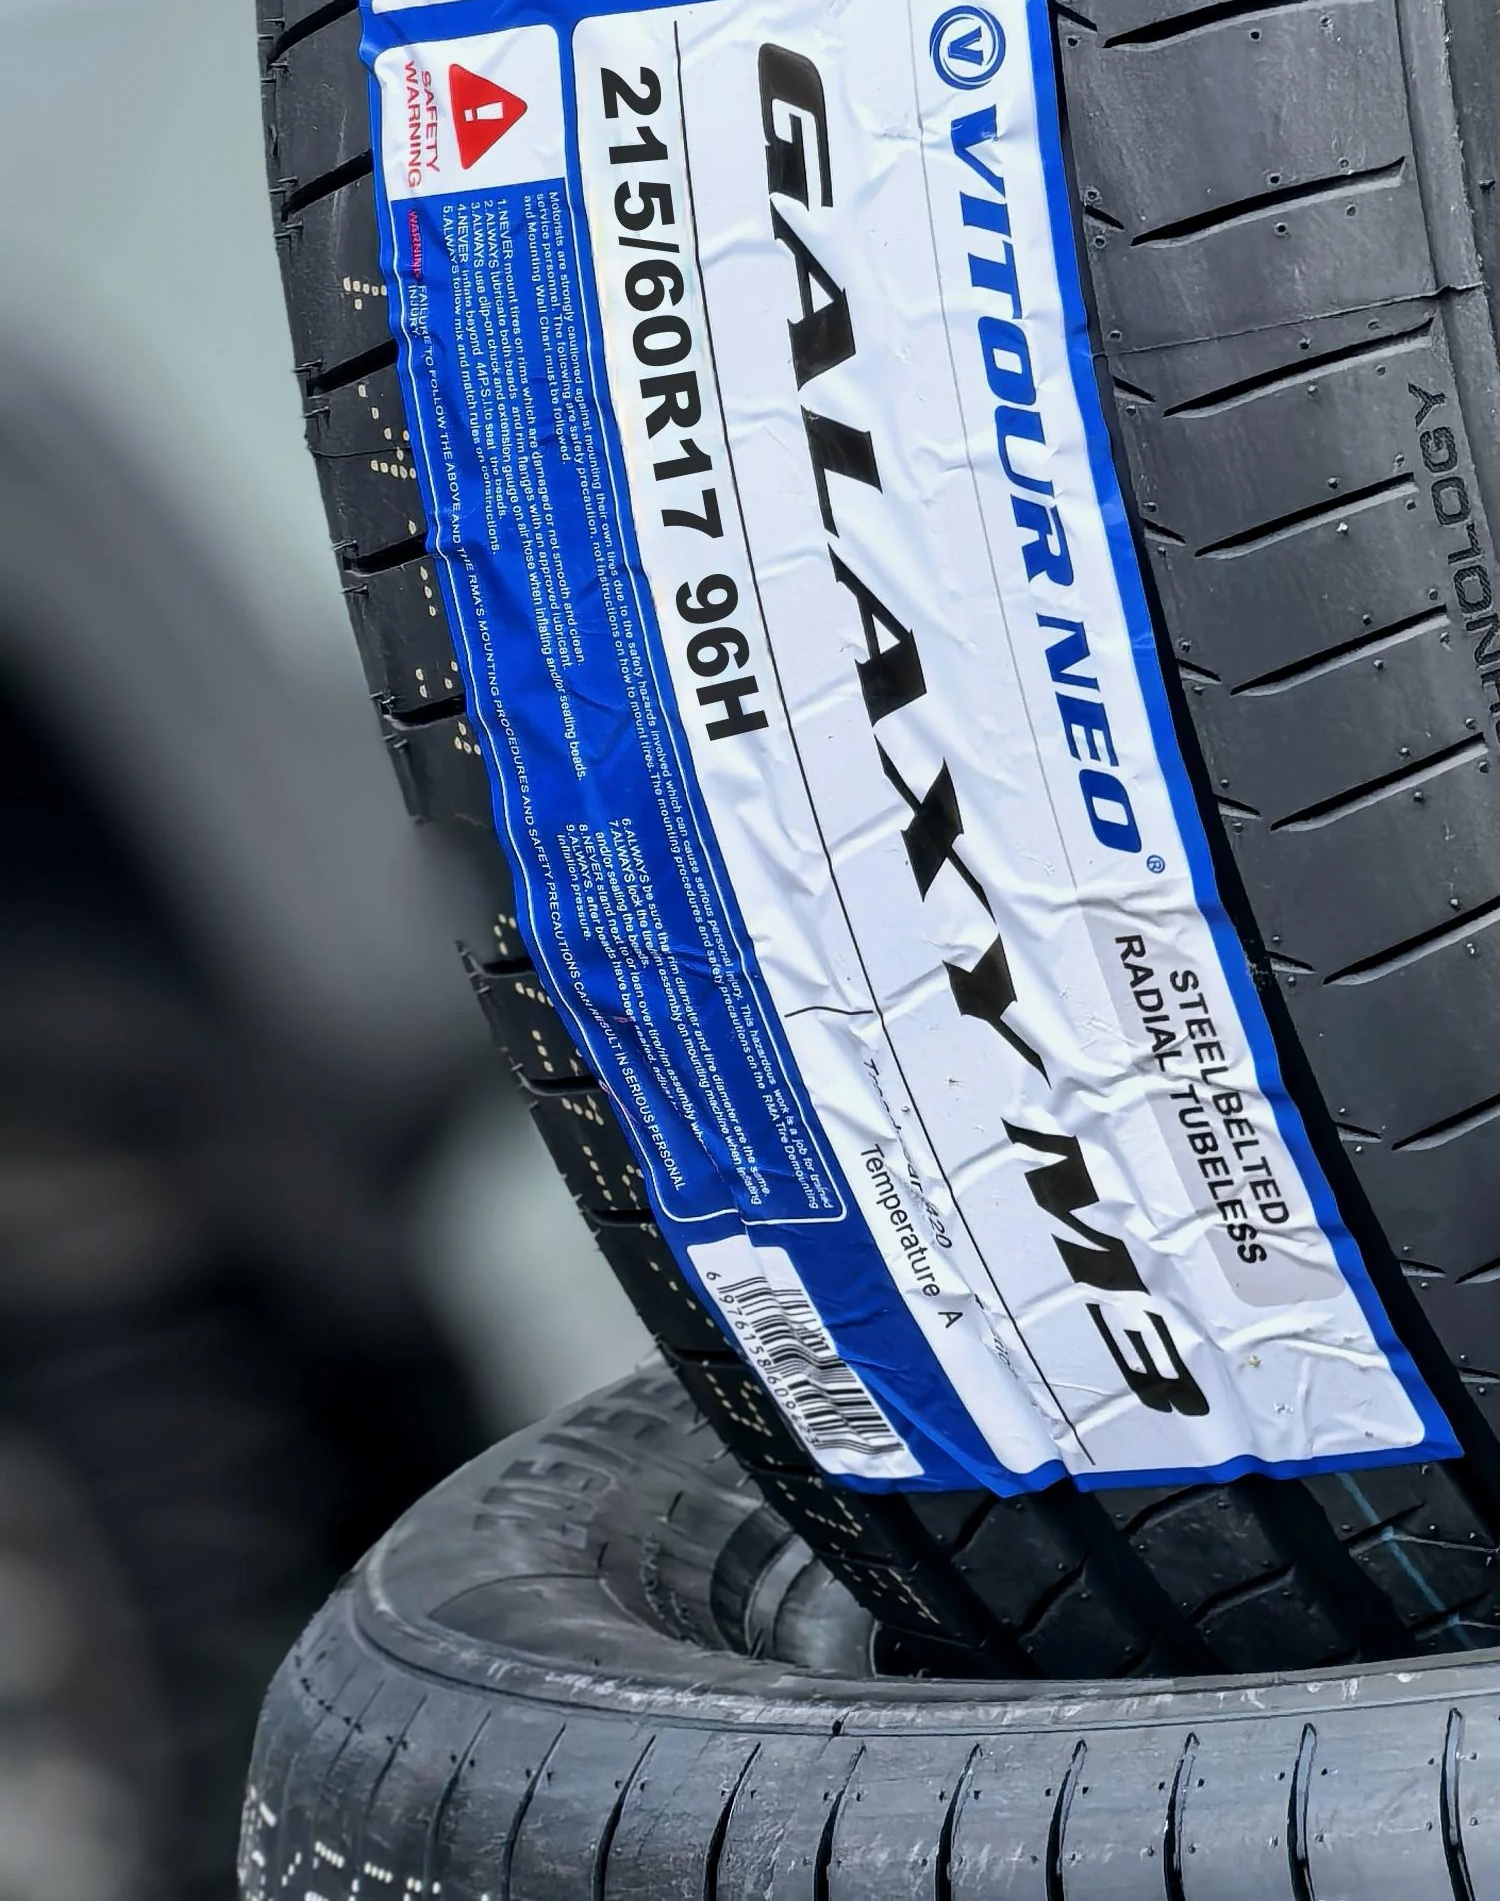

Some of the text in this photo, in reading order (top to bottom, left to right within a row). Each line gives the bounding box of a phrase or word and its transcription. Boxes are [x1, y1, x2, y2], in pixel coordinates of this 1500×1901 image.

[402, 60, 423, 189] WARNING
[420, 69, 441, 174] SAFETY
[601, 65, 770, 741] 215/60R17 96H
[951, 105, 1076, 592] VITOUR
[1036, 610, 1143, 854] NEO
[757, 42, 1211, 1419] GALAXY M3
[657, 931, 672, 953] tha
[1114, 934, 1268, 1265] RADIAL TUBELESS
[1169, 969, 1290, 1225] STEEL BELTED
[860, 1143, 941, 1298] Temperature
[938, 1310, 963, 1329] A
